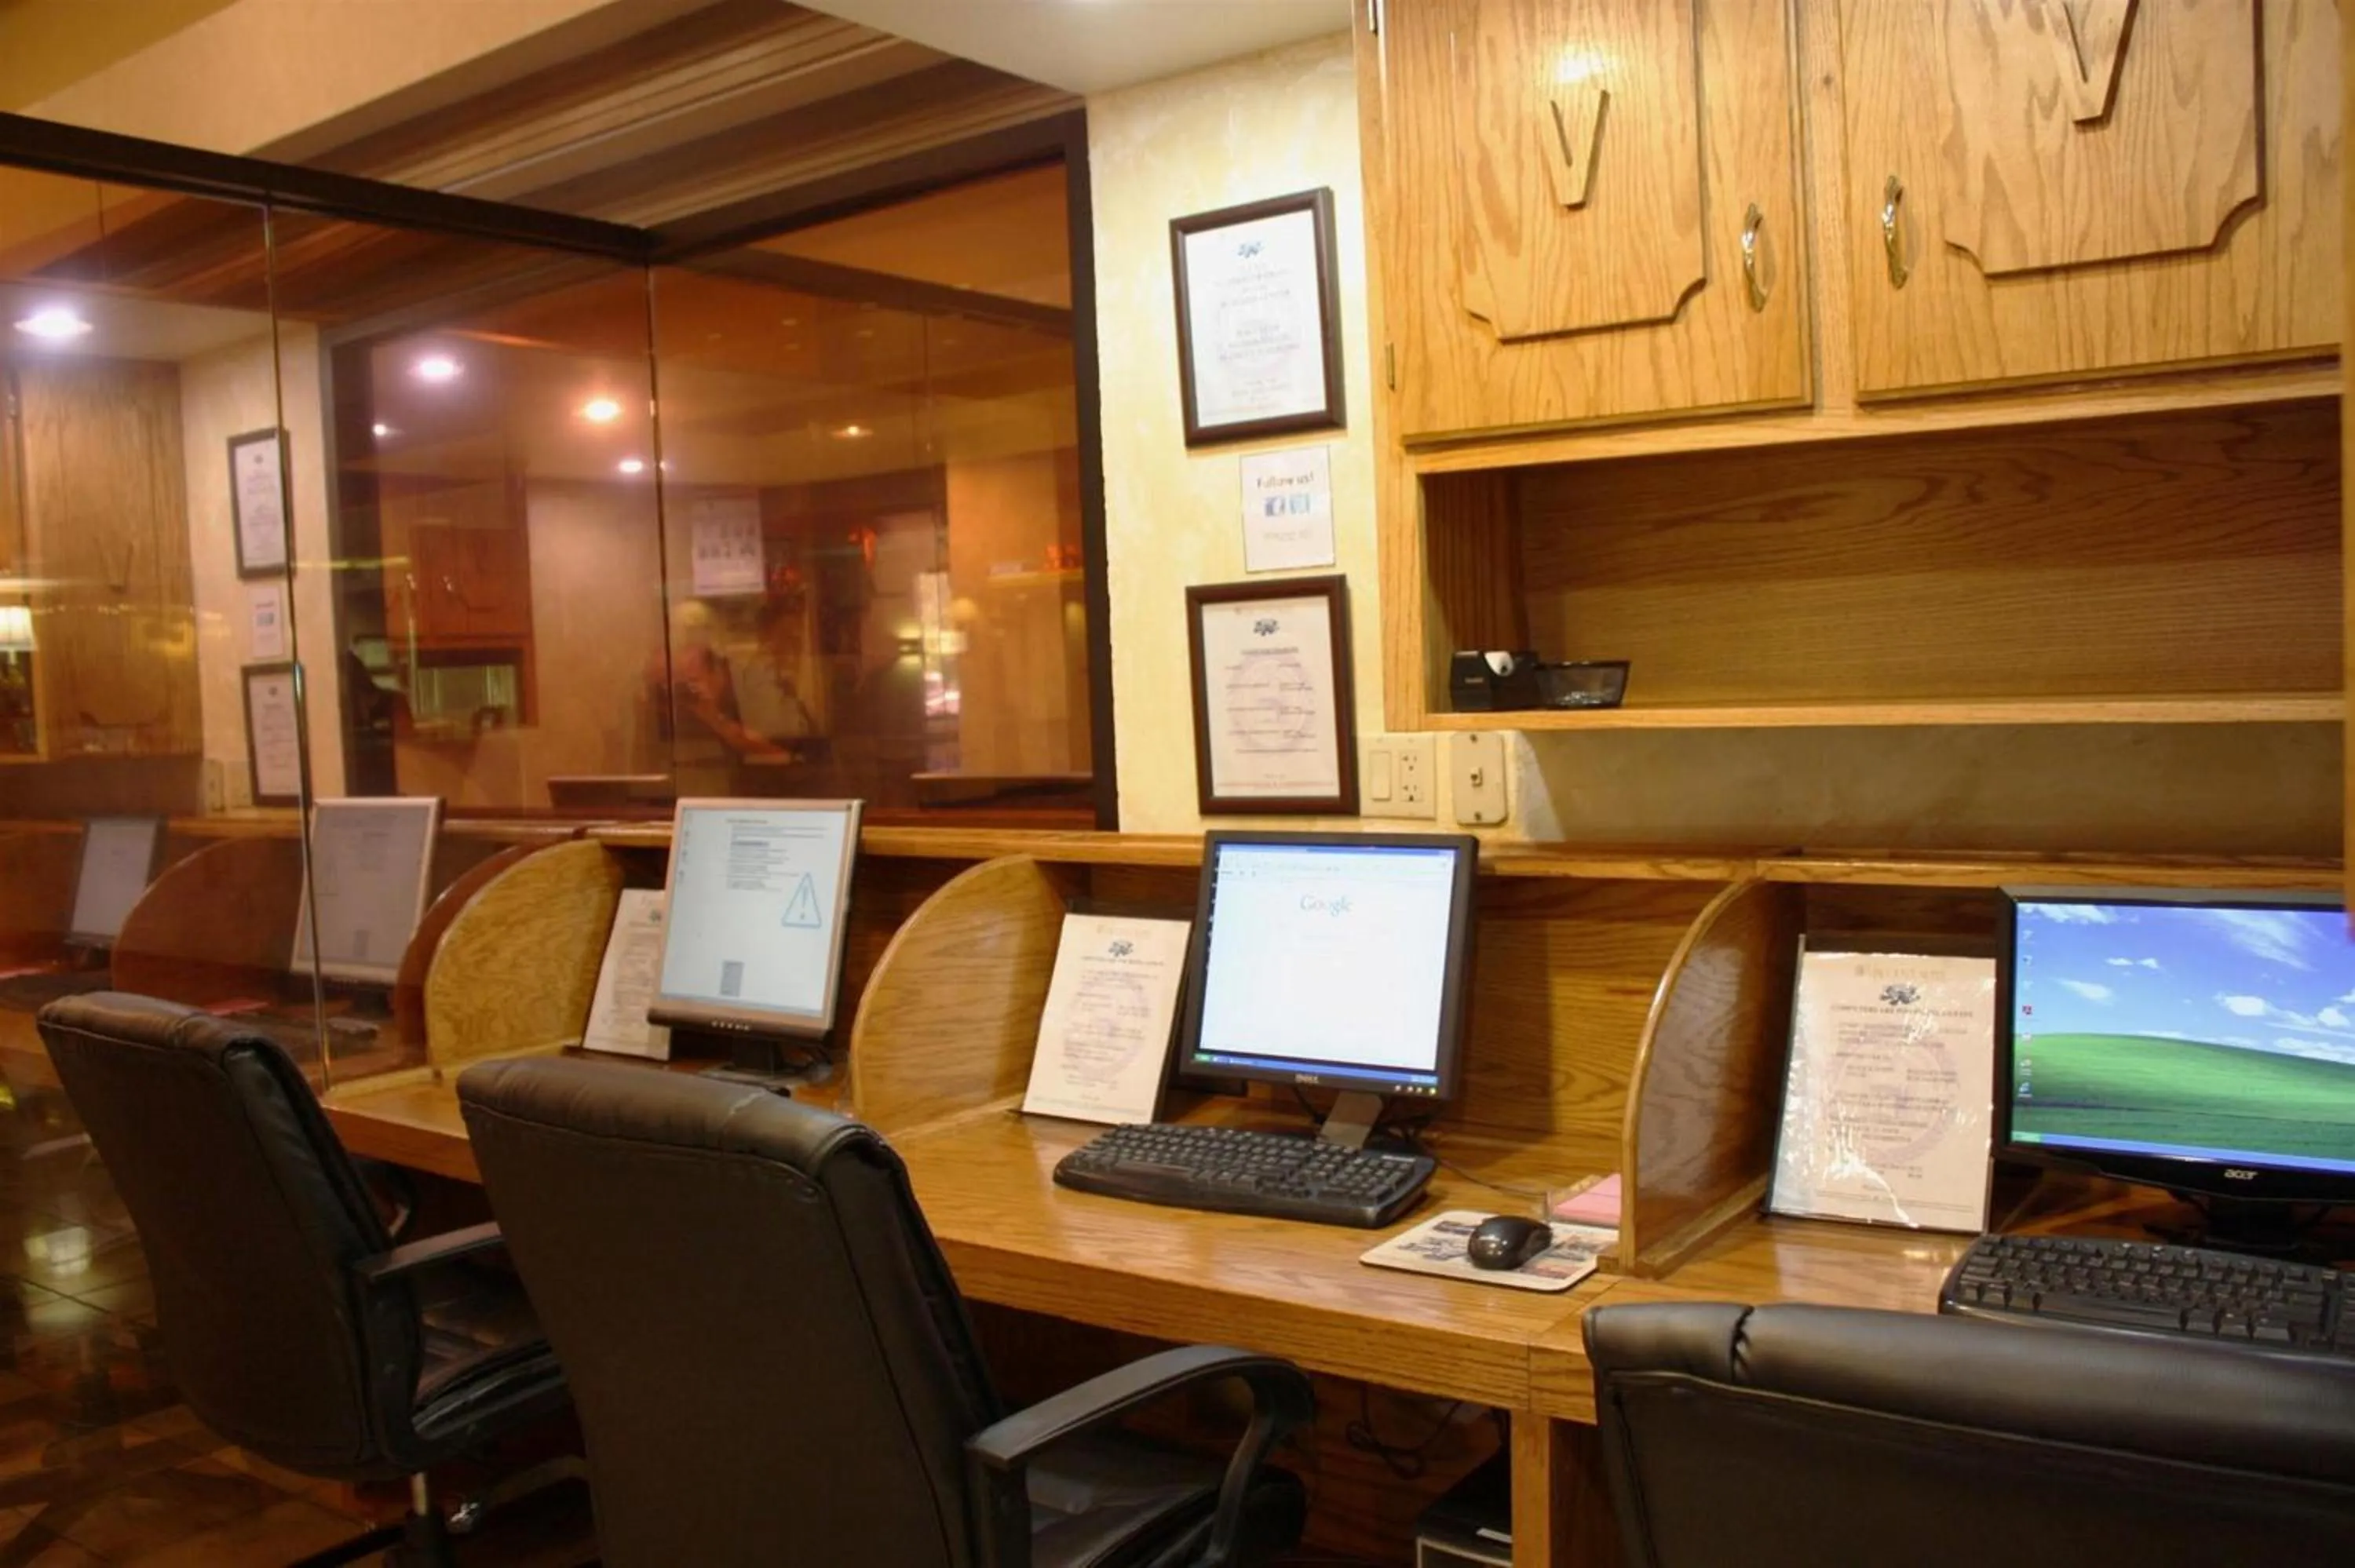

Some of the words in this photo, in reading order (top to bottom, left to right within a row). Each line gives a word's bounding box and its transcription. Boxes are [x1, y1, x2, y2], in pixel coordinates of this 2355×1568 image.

[1257, 475, 1294, 489] Follow
[1296, 470, 1314, 485] us!
[1299, 893, 1354, 917] Google
[2224, 1168, 2258, 1180] acer
